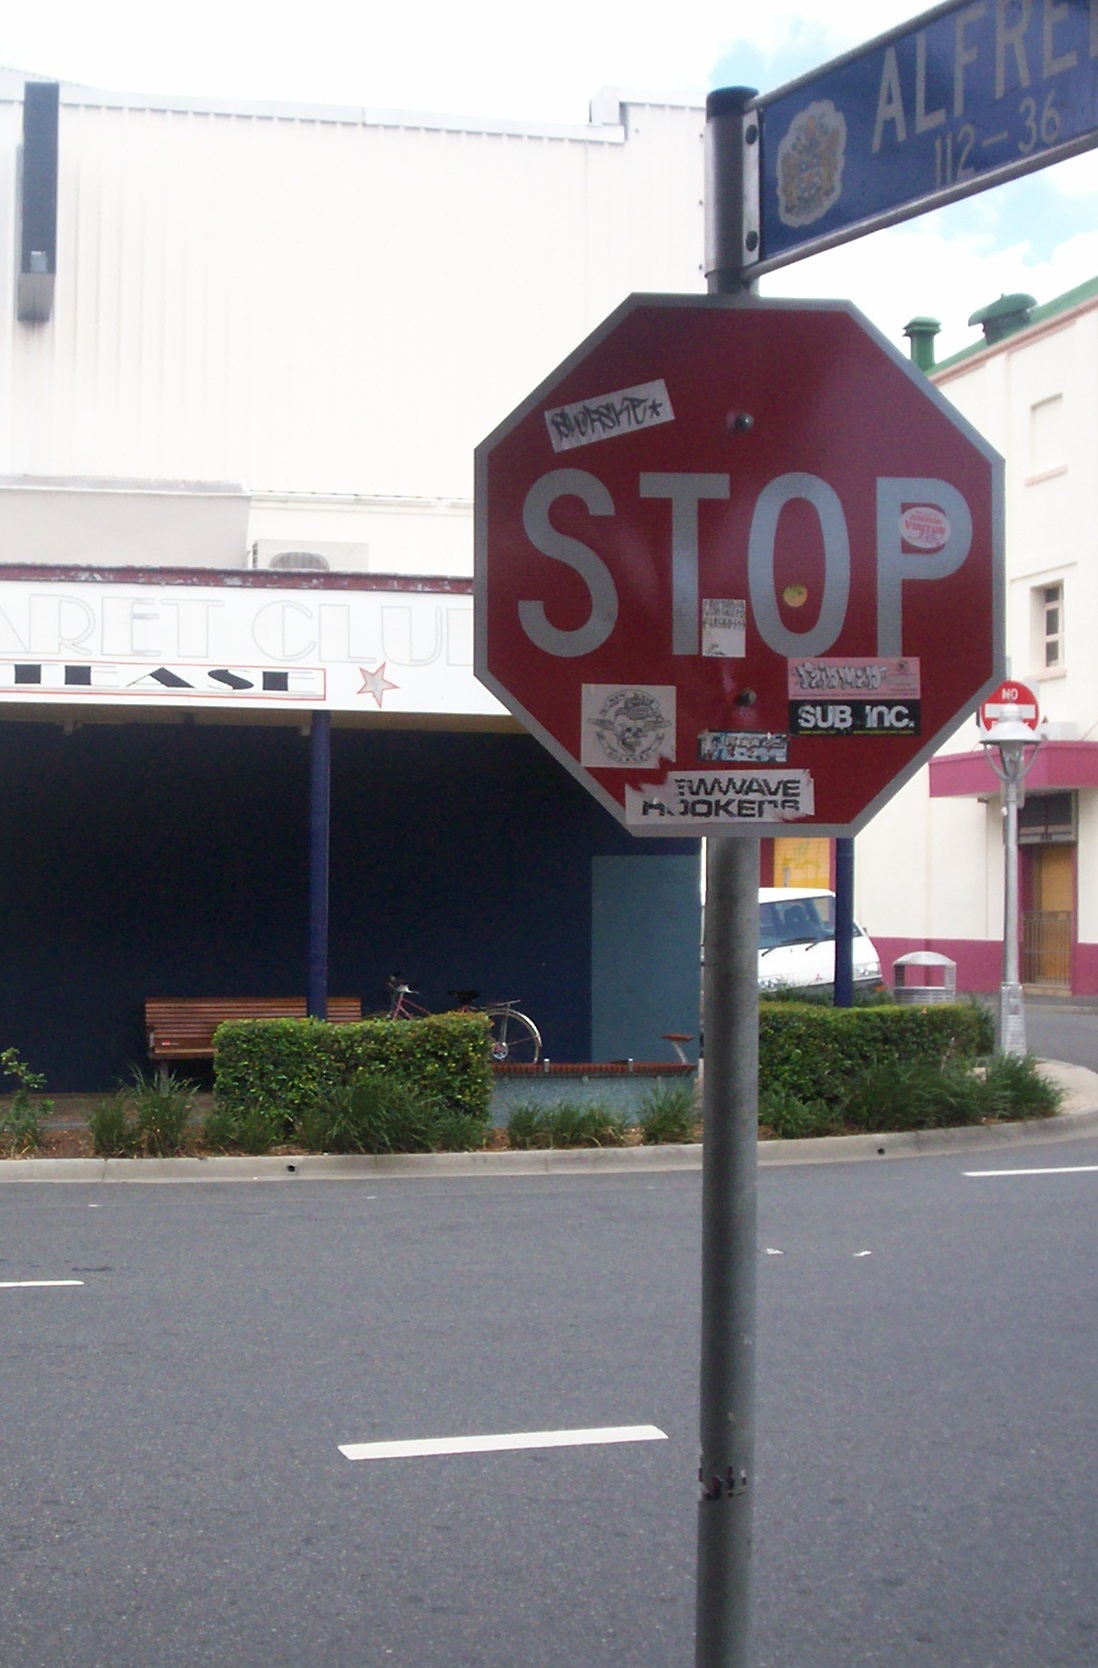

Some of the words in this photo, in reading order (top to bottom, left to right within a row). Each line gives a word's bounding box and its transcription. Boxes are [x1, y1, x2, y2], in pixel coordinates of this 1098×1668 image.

[872, 0, 1098, 154] ALFRE
[517, 466, 974, 659] STOP
[798, 704, 853, 730] SUB
[1002, 688, 1019, 700] NO
